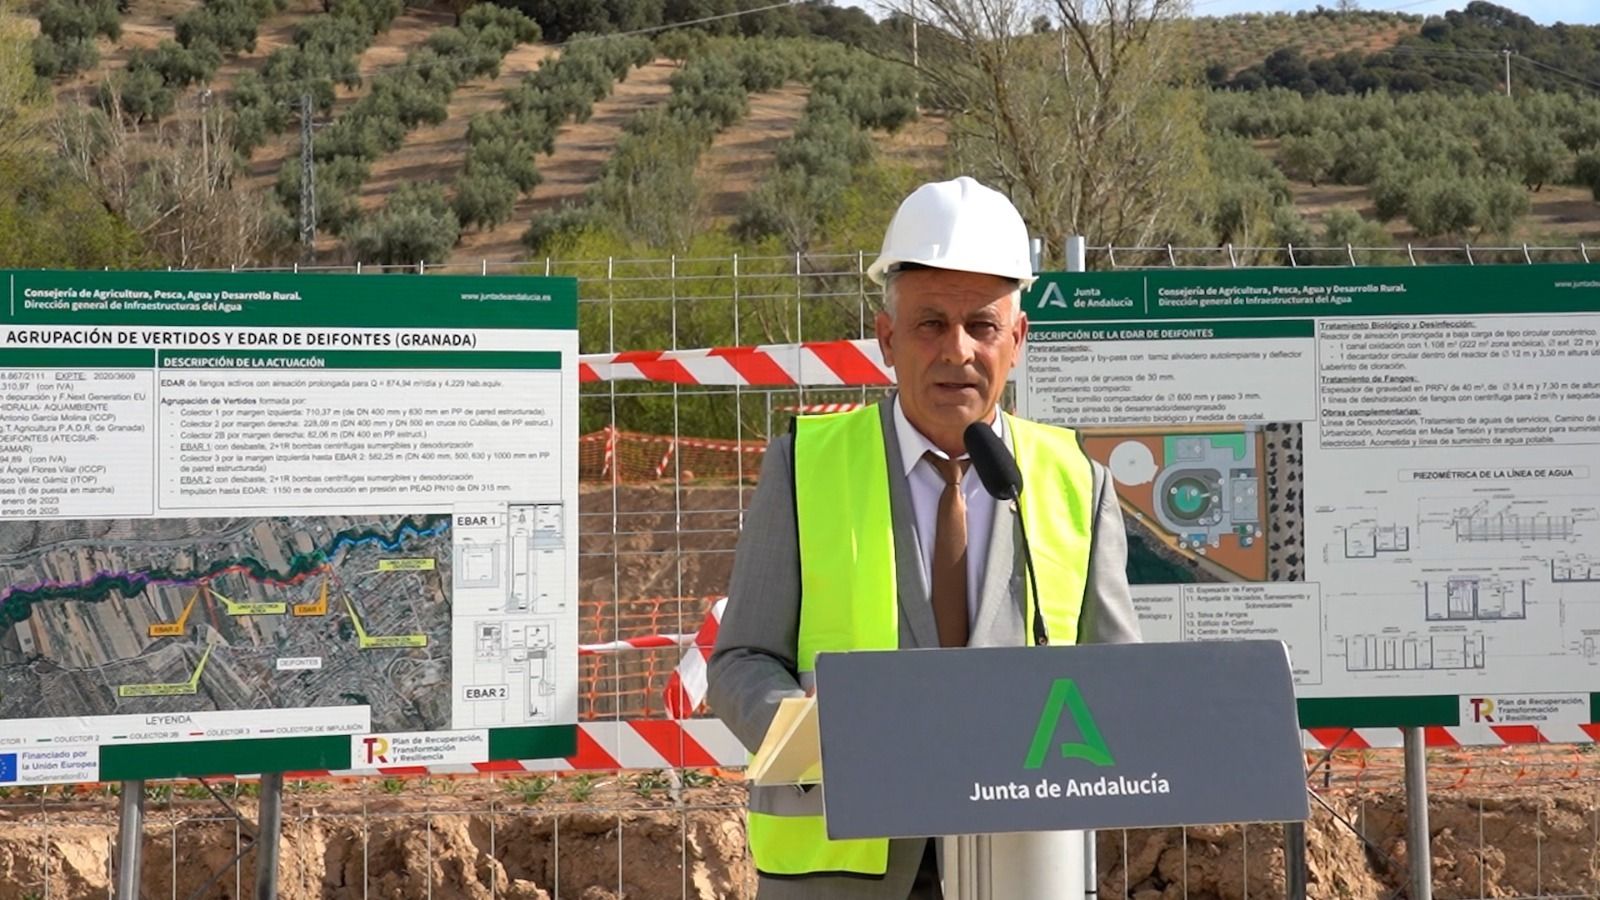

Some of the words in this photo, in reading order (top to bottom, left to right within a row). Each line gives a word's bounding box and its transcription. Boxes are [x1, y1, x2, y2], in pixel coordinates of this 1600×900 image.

[24, 287, 78, 299] Consejería
[79, 289, 92, 298] de
[93, 289, 153, 301] Agricultura,
[154, 290, 186, 301] Pesca,
[187, 291, 212, 301] Agua
[213, 293, 220, 302] y
[221, 291, 271, 300] Desarrollo
[273, 291, 302, 301] Rural.
[1074, 288, 1101, 297] Junta
[1158, 286, 1205, 299] Consejería
[1206, 287, 1217, 295] de
[1218, 286, 1271, 297] Agricultura,
[1272, 286, 1301, 296] Pesca,
[1302, 285, 1325, 296] Agua
[1326, 286, 1332, 295] y
[1333, 284, 1379, 293] Desarrollo
[1380, 284, 1407, 292] Rural.
[1074, 298, 1086, 308] de
[1087, 297, 1133, 307] Andalucía
[1158, 296, 1198, 306] Dirección
[1199, 296, 1232, 307] general
[1233, 297, 1244, 305] de
[1246, 294, 1314, 305] Infraestructuras
[1315, 294, 1329, 304] del
[1330, 295, 1352, 305] Agua
[24, 300, 70, 309] Dirección
[71, 300, 108, 312] general
[109, 300, 122, 310] de
[124, 300, 200, 311] Infraestructuras
[201, 301, 217, 311] del
[218, 302, 242, 313] Agua
[6, 328, 112, 344] AGRUPACIÓN
[118, 331, 137, 344] DE
[142, 331, 221, 345] VERTIDOS
[224, 332, 234, 345] Y
[238, 332, 278, 345] EDAR
[283, 333, 301, 345] DE
[307, 333, 391, 346] DEIFONTES
[395, 333, 476, 349] (GRANADA)
[1027, 330, 1090, 340] DESCRIPCIÓN
[1092, 331, 1104, 340] DE
[1107, 331, 1118, 339] LA
[1120, 330, 1145, 339] EDAR
[1146, 330, 1159, 338] DE
[1161, 329, 1213, 338] DEIFONTES
[164, 357, 234, 367] DESCRIPCIÓN
[236, 358, 249, 367] DE
[252, 358, 264, 367] LA
[266, 357, 324, 367] ACTUACIÓN
[1413, 470, 1478, 480] PIEZOMÉTRICA
[1479, 470, 1491, 479] DE
[1493, 471, 1505, 479] LA
[1507, 469, 1533, 478] LÍNEA
[1534, 469, 1546, 478] DE
[1548, 469, 1573, 477] AGUA
[457, 516, 487, 526] EBAR
[491, 516, 495, 525] 1
[466, 688, 497, 699] EBAR
[499, 688, 505, 697] 2
[1529, 698, 1585, 706] Recuperación,
[145, 715, 192, 725] LEYENDA
[412, 737, 422, 745] de
[425, 735, 483, 745] Recuperación,
[392, 745, 456, 753] Transformación
[22, 751, 70, 760] Financiado
[72, 751, 87, 759] por
[22, 763, 30, 771] la
[32, 762, 58, 770] Unión
[60, 760, 97, 769] Europea
[969, 782, 1030, 800] Junta
[1035, 779, 1061, 798] de
[1066, 770, 1170, 795] Andalucía
